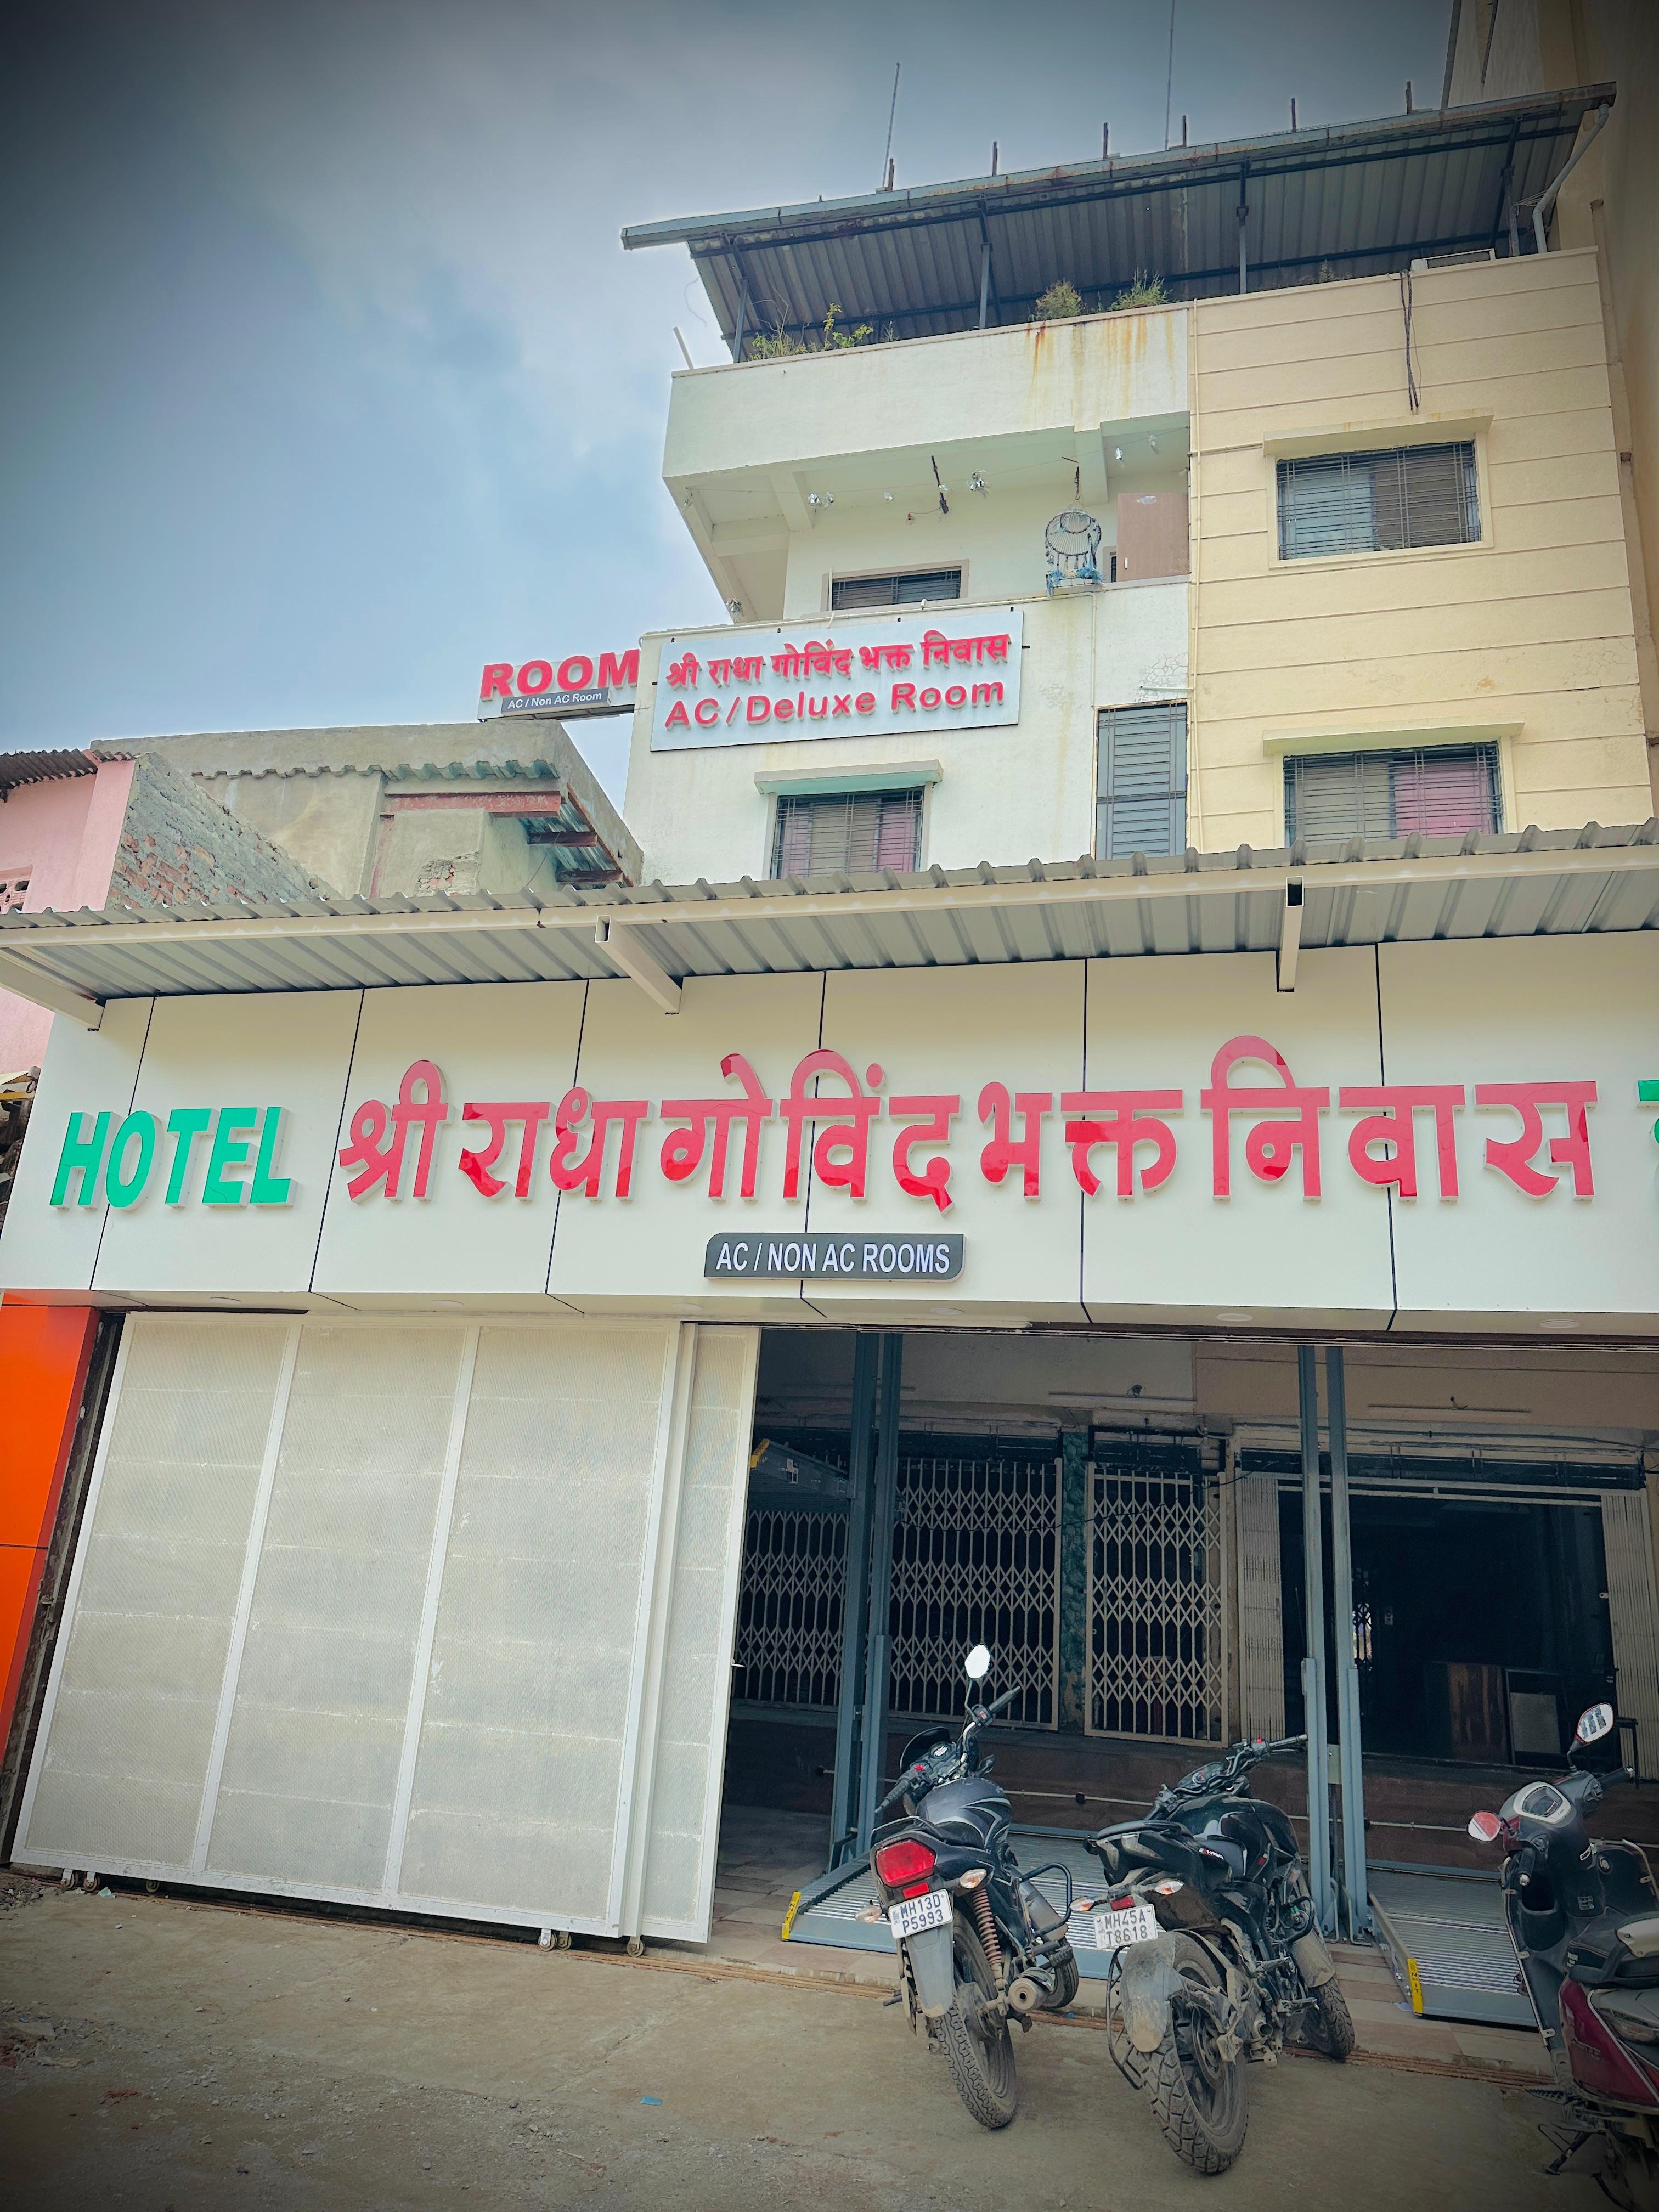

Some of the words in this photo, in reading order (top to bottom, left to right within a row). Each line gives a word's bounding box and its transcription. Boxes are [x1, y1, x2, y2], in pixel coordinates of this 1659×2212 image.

[666, 652, 700, 687] श्री
[707, 656, 764, 685] राधा
[770, 638, 853, 679] गोविंद
[859, 644, 915, 672] भक्त
[920, 629, 1011, 668] निवास
[480, 649, 640, 698] ROOM
[507, 698, 523, 709] AC
[531, 697, 552, 707] Non
[554, 694, 569, 704] AC
[572, 692, 602, 703] Room
[891, 682, 1005, 712] Room
[338, 1059, 449, 1203] श्री
[458, 1087, 651, 1200] राधा
[659, 1048, 961, 1215] गोविंद
[978, 1081, 1183, 1200] भक्त
[1200, 1035, 1598, 1200] निवास
[50, 1107, 291, 1209] HOTEL
[715, 1242, 749, 1271] AC
[768, 1242, 817, 1272] NON
[821, 1242, 855, 1272] AC
[862, 1243, 950, 1273] ROOMS
[900, 1894, 941, 1918] MH13D
[1104, 1909, 1146, 1929] MH45A
[902, 1909, 944, 1934] P5993
[1106, 1925, 1148, 1945] T8618
